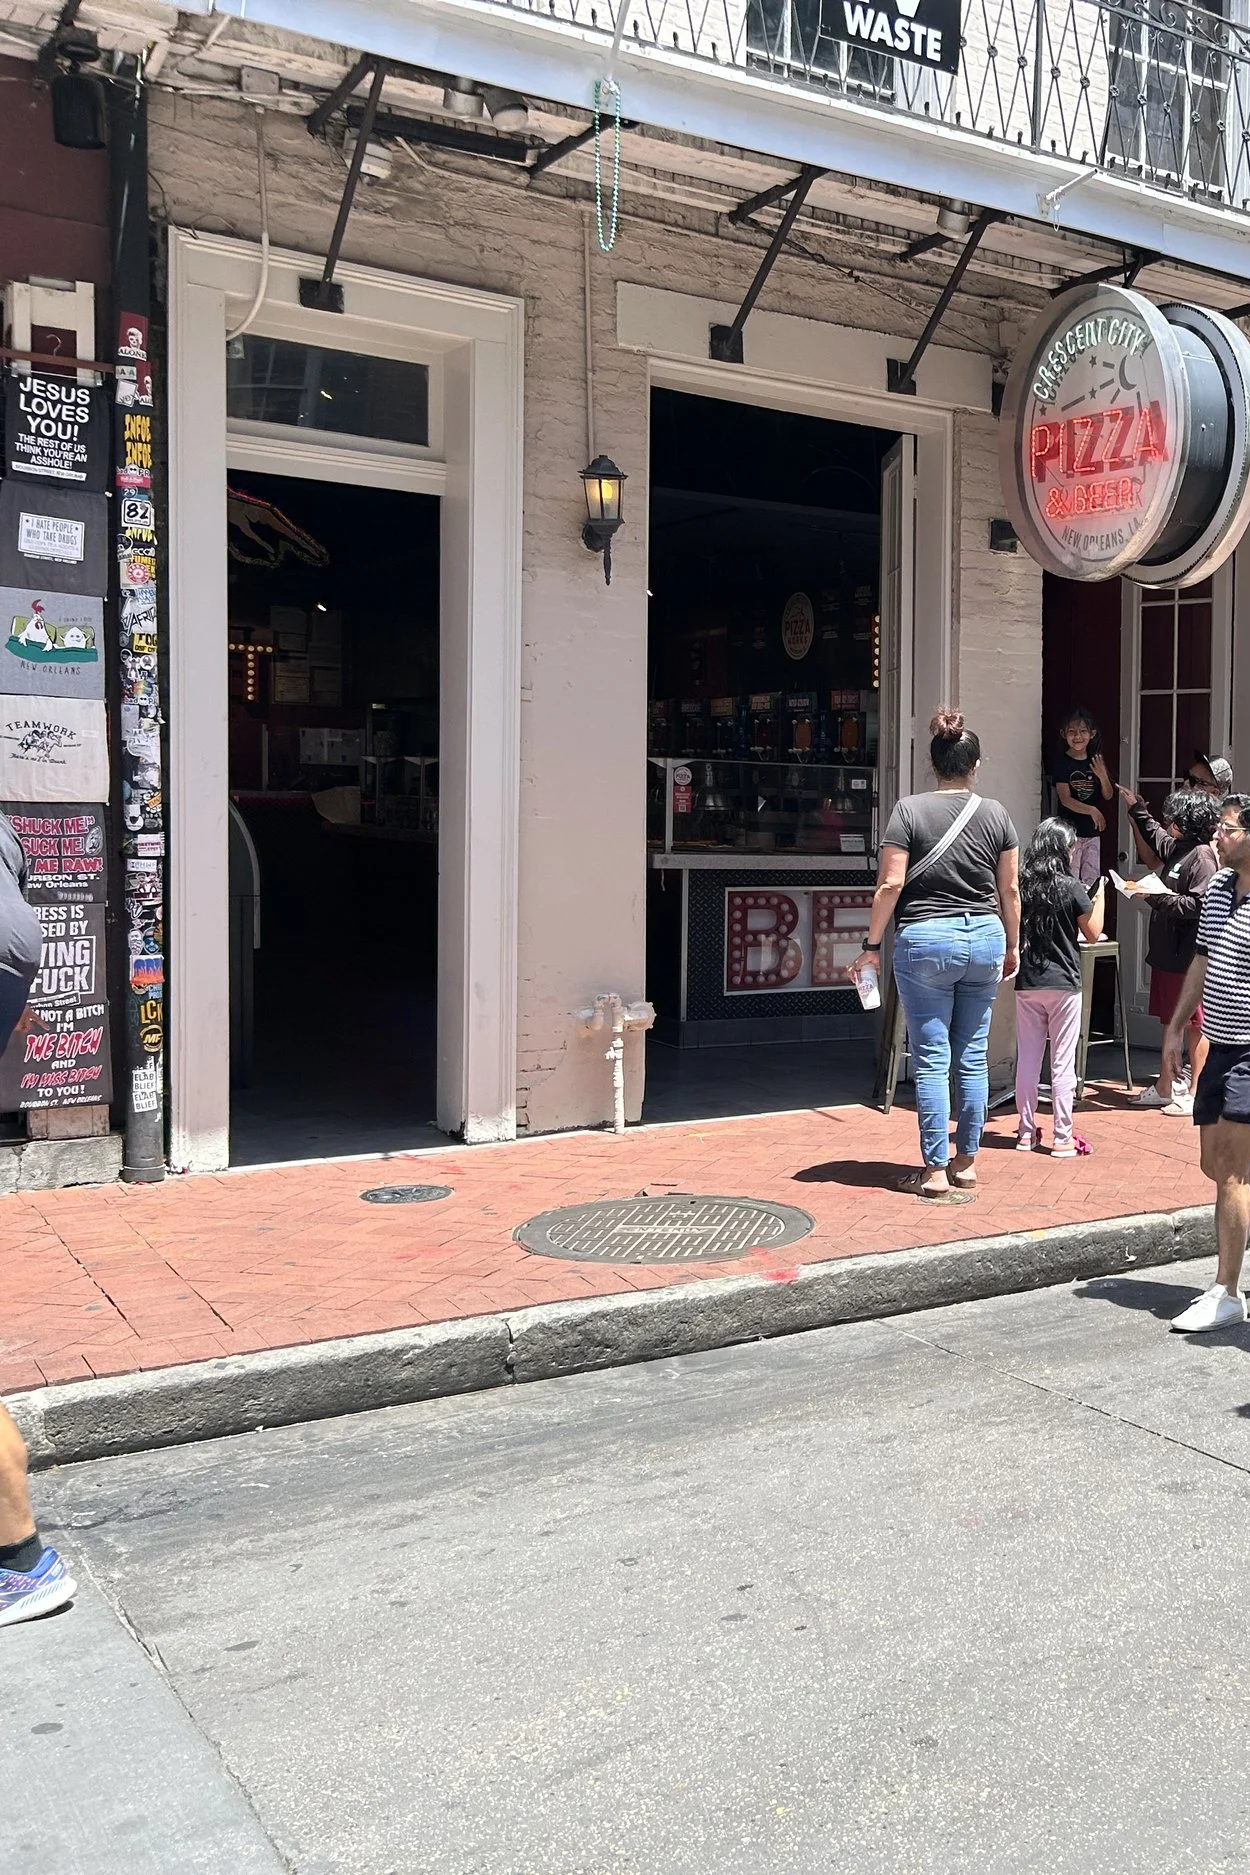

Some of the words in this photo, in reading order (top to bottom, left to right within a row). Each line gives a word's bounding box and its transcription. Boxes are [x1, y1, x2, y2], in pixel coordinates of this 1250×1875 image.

[843, 1, 942, 62] WASTE
[1033, 317, 1109, 400] CRESCENT
[1108, 317, 1150, 357] CITY
[20, 377, 90, 405] JESUS
[20, 393, 90, 424] LOVES
[26, 415, 79, 442] YOU!
[18, 433, 38, 445] THE
[37, 437, 60, 450] REST
[60, 442, 73, 452] OF
[74, 444, 86, 454] US
[1031, 402, 1168, 482] PIZZA
[14, 442, 42, 456] THINK
[43, 448, 74, 461] YOU'RE
[74, 454, 88, 462] AN
[30, 456, 72, 469] ASSHOLE!
[1045, 487, 1068, 518] &
[1074, 477, 1141, 515] BEER
[36, 519, 50, 530] HATE
[52, 521, 74, 534] PEOPLE
[26, 528, 40, 540] WHO
[43, 531, 56, 542] TAKE
[58, 533, 77, 546] DRUGS
[1062, 526, 1080, 550] NEW
[784, 620, 810, 636] PIZZA
[20, 660, 37, 671] NEW
[43, 665, 81, 676] ORLEANS
[6, 720, 76, 740] TEAMWORK
[20, 837, 60, 856] SUCK
[34, 858, 58, 874] ME
[62, 857, 104, 874] RAW!
[34, 906, 68, 920] RESS
[70, 904, 84, 919] IS
[41, 922, 66, 938] SED
[70, 920, 88, 936] BY
[40, 940, 90, 968] VING
[30, 966, 90, 994] FUCK
[54, 996, 76, 1006] Street
[41, 1010, 62, 1022] NOT
[65, 1009, 74, 1022] A
[76, 1004, 104, 1020] BITCH
[56, 1022, 74, 1032] I'M
[24, 1033, 58, 1063] THE
[56, 1026, 104, 1058] BITCH
[51, 1060, 76, 1070] AND
[68, 1064, 102, 1083] BITCH
[37, 1088, 54, 1098] TO
[76, 1095, 102, 1104] ORLEANS
